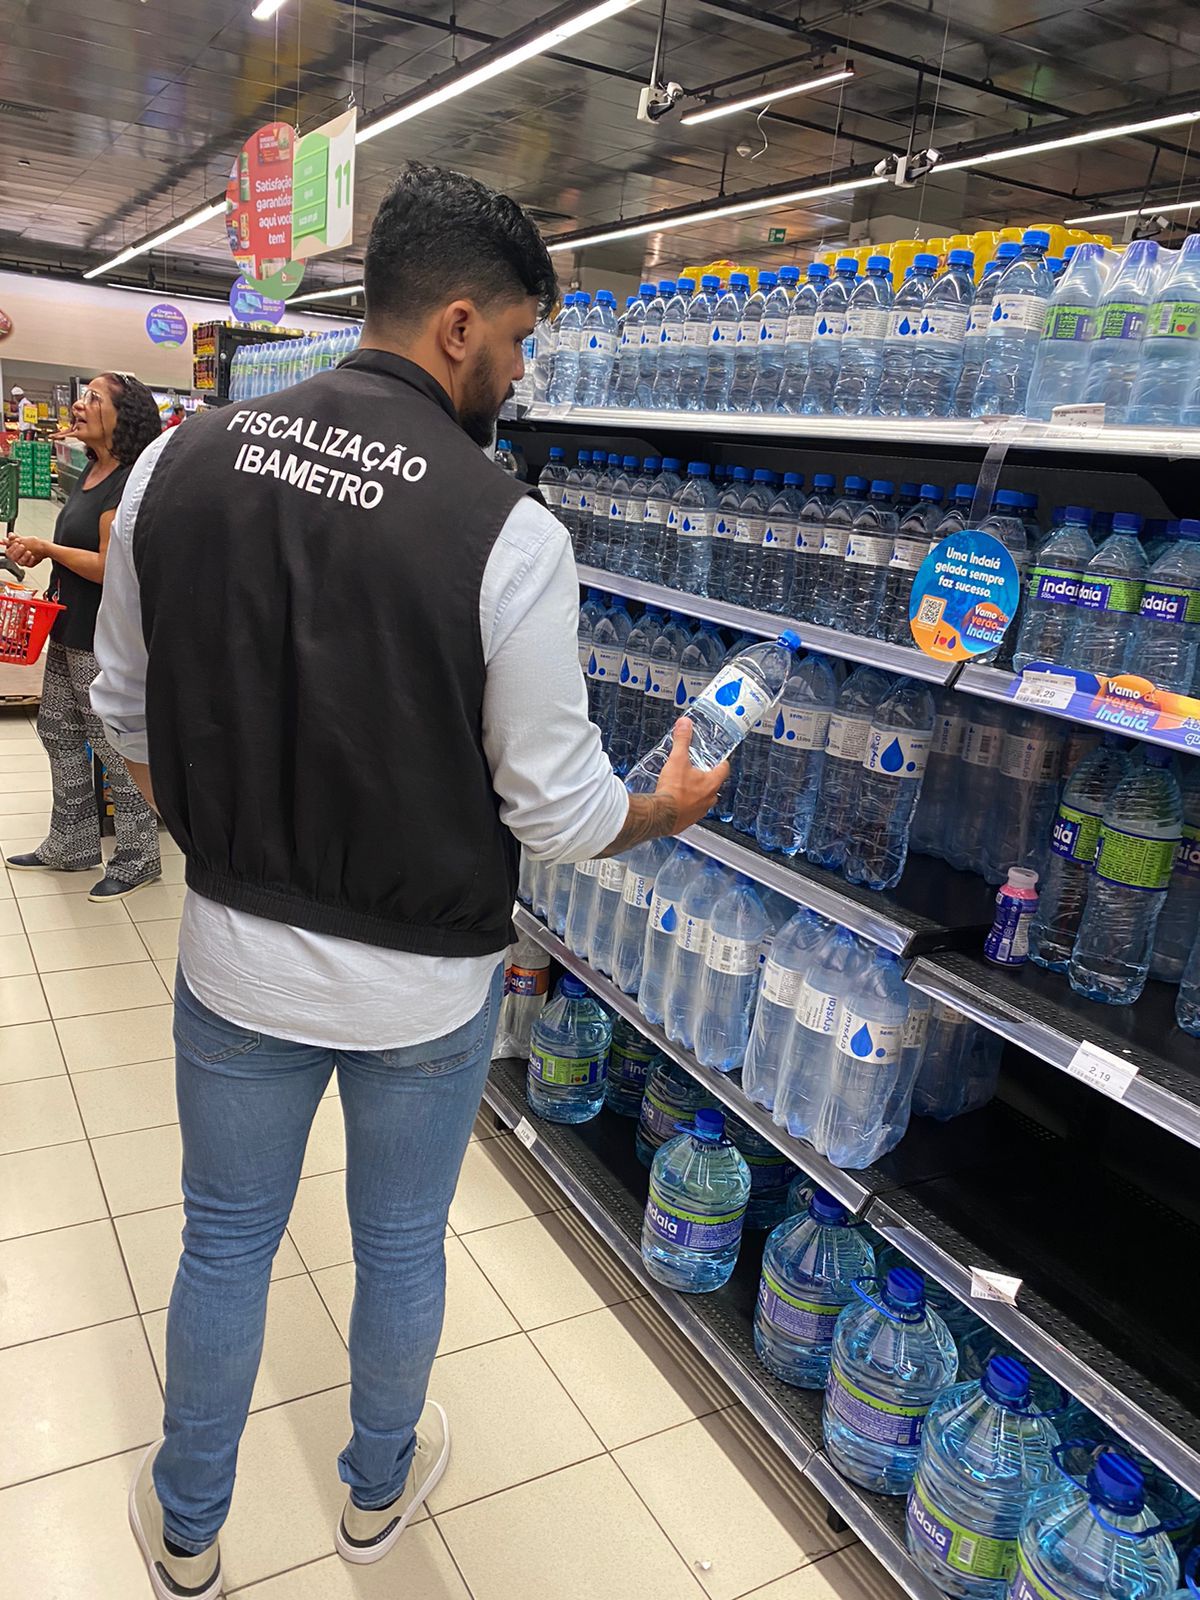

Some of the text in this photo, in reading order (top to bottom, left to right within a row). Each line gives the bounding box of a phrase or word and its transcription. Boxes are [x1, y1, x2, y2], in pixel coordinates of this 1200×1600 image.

[334, 160, 351, 208] 11
[259, 213, 277, 230] aqui
[268, 231, 286, 245] tem!
[226, 410, 427, 482] FISCALIZAÇÃO
[234, 443, 384, 510] IBAMETRO
[946, 546, 1001, 570] Uma Indaiá
[935, 562, 1005, 586] gelada sempre
[938, 575, 992, 599] faz sucesso.
[1042, 579, 1079, 596] indai
[975, 605, 998, 619] Vamo
[1108, 681, 1141, 699] Vamo
[823, 996, 838, 1032] crystal
[840, 1012, 853, 1049] crystal
